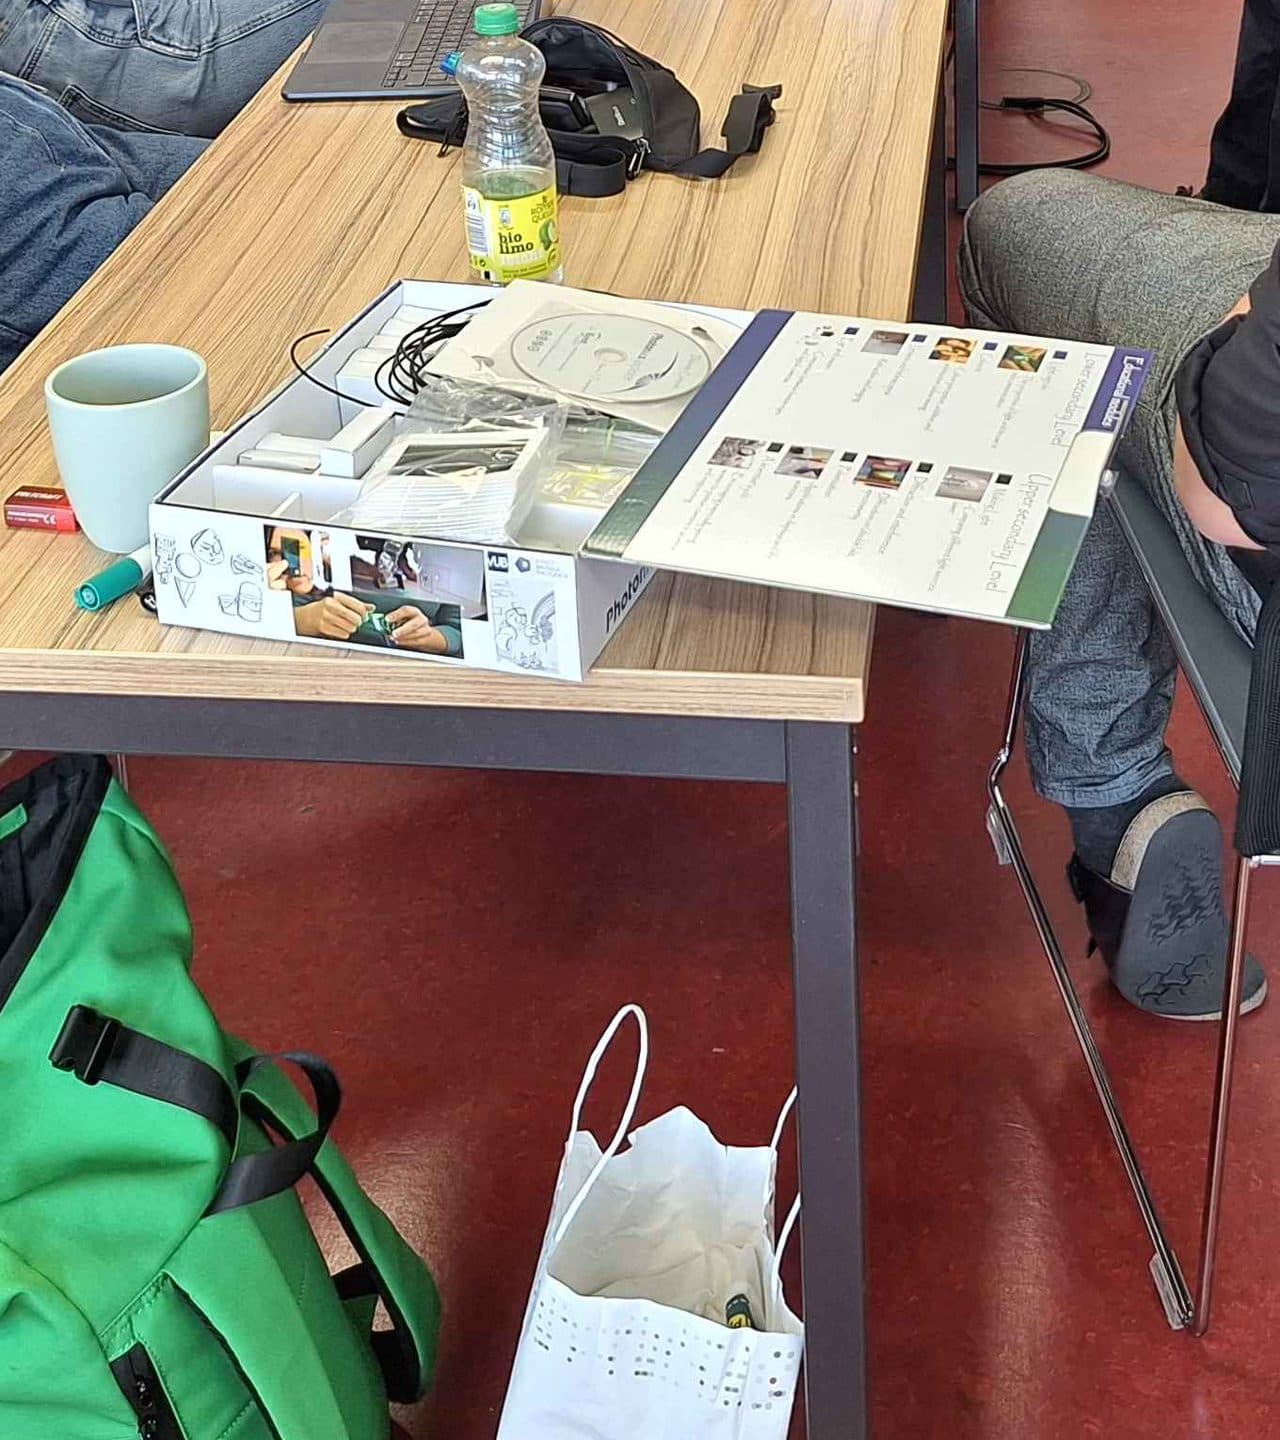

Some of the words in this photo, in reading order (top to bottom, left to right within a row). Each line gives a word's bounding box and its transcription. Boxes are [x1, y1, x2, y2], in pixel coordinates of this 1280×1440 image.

[498, 232, 522, 243] bio
[499, 242, 534, 254] limo
[1081, 352, 1107, 379] Lower
[1113, 356, 1144, 399] Educational
[1056, 379, 1087, 420] secondary
[1048, 421, 1079, 447] Level
[1018, 474, 1052, 508] Upper
[991, 508, 1026, 560] secondary
[488, 554, 508, 568] VUB
[985, 561, 1017, 593] Level
[606, 566, 650, 633] Photon
